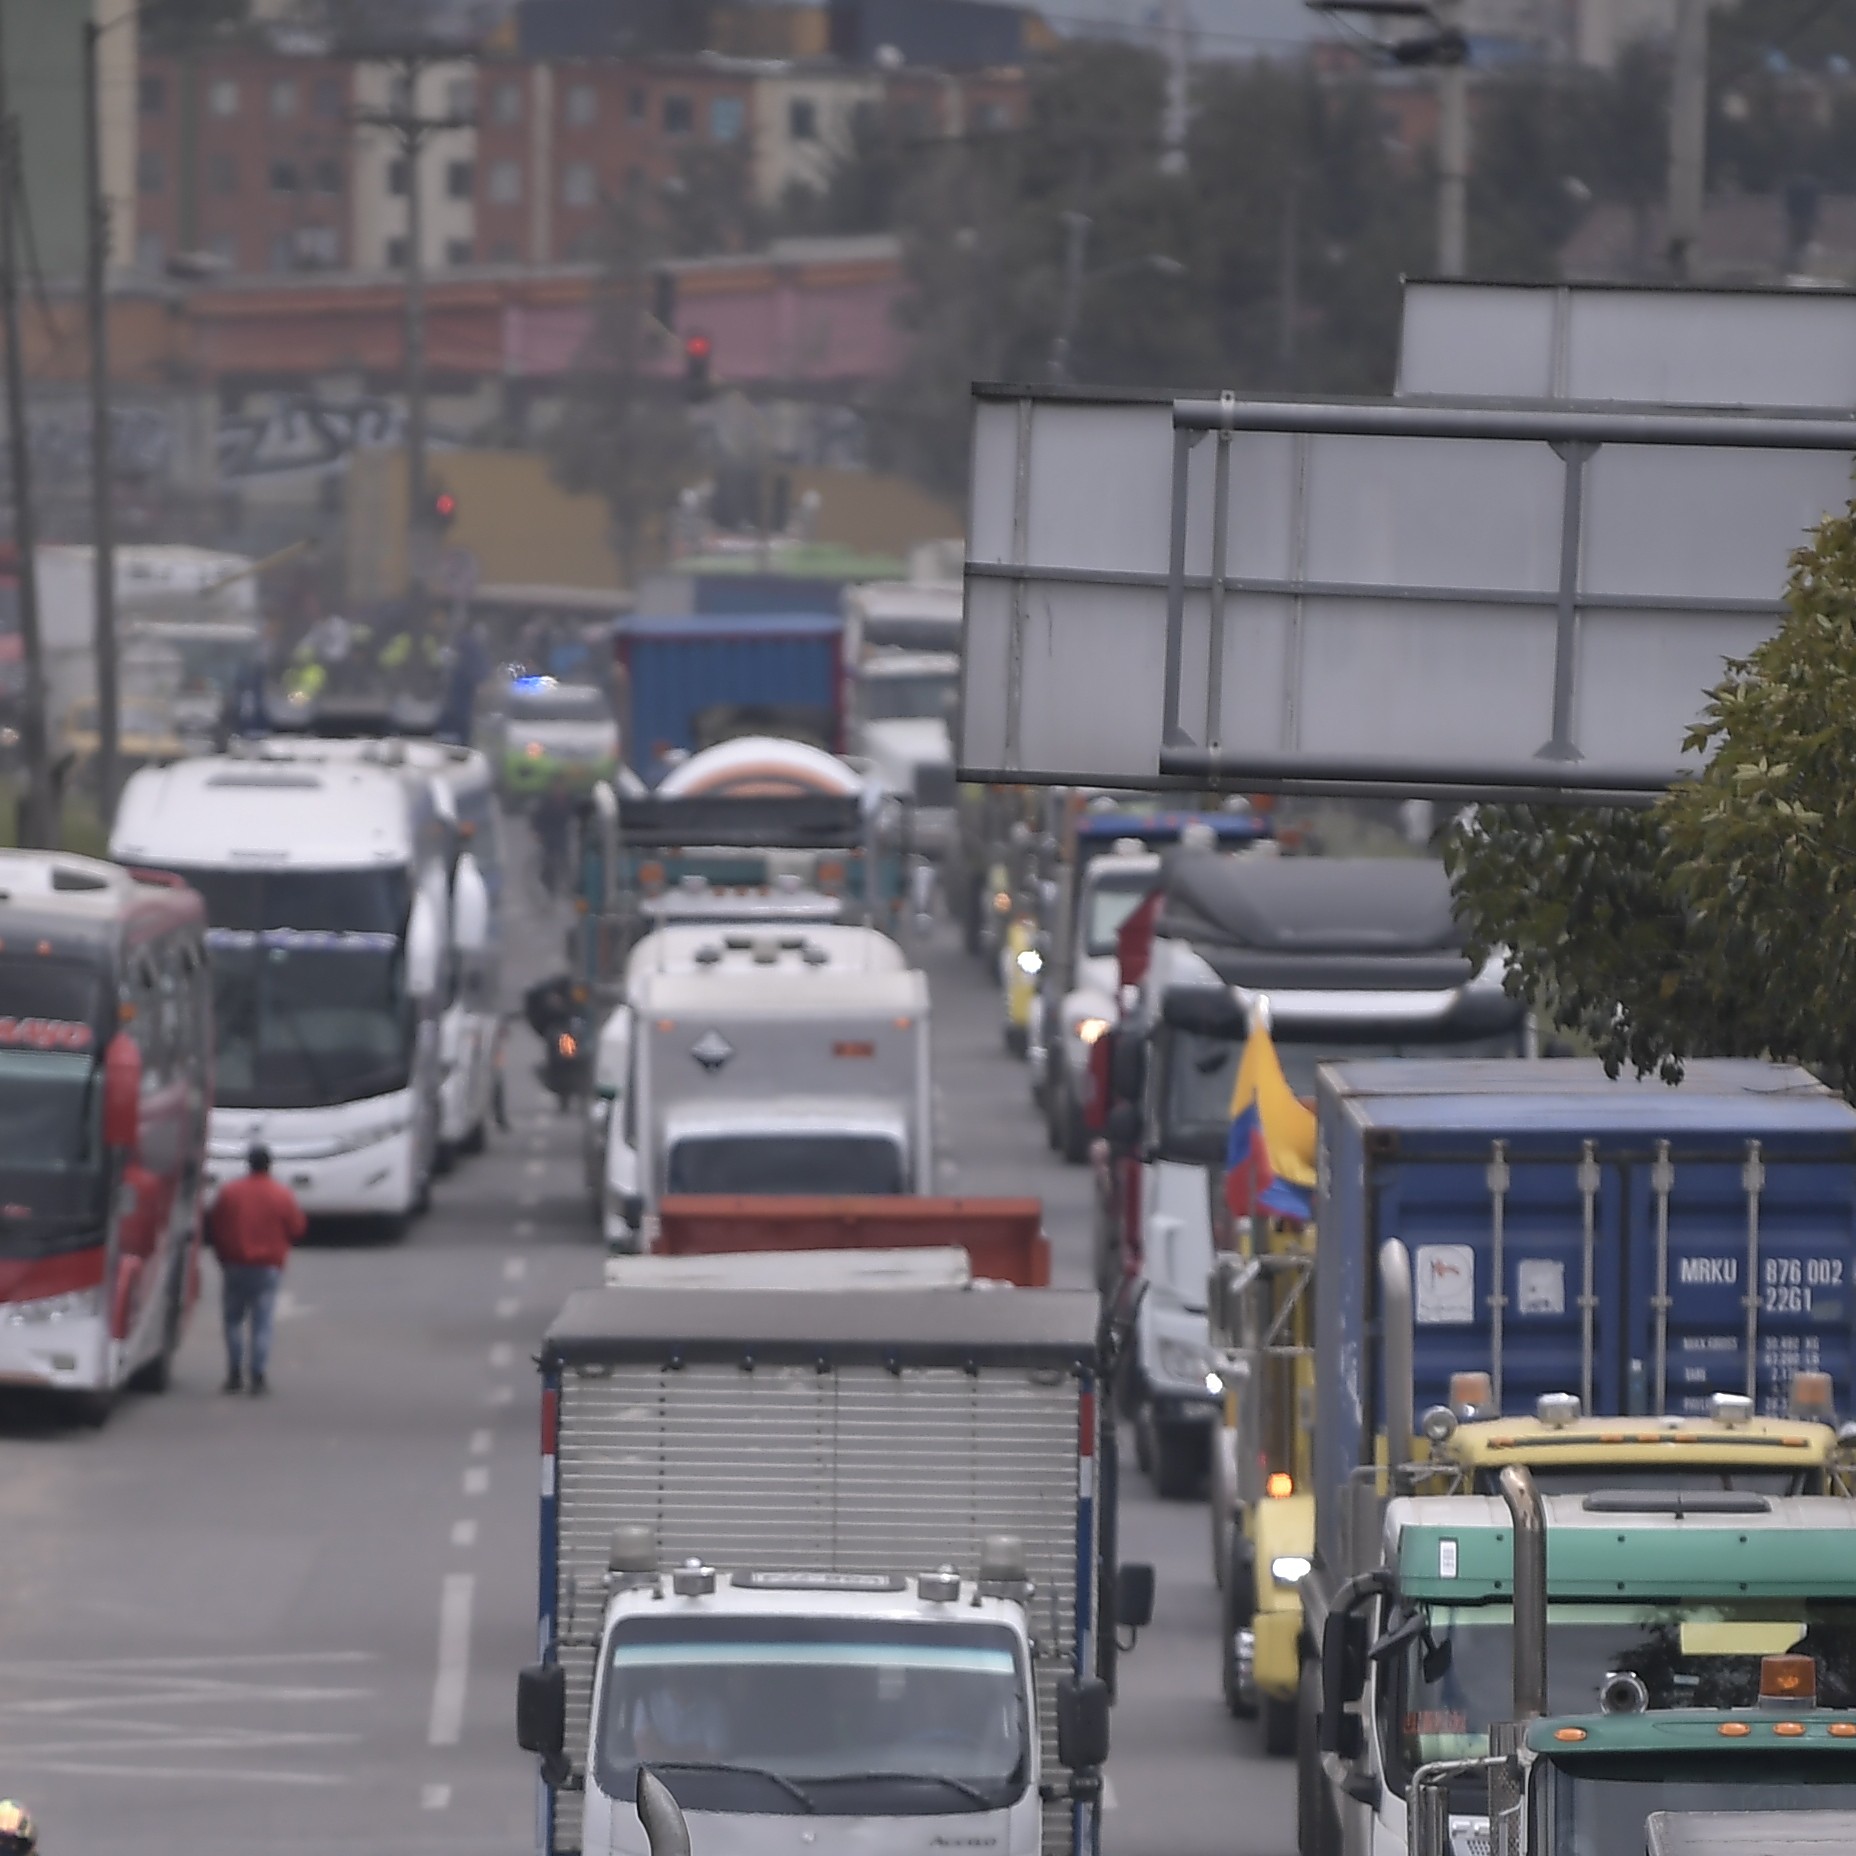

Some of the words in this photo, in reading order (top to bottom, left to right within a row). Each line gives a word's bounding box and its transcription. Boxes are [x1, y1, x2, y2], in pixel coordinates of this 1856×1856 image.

[1681, 1258, 1737, 1284] MRKU
[1766, 1258, 1801, 1285] 876
[1807, 1258, 1843, 1285] 002
[1766, 1286, 1811, 1312] 22G1
